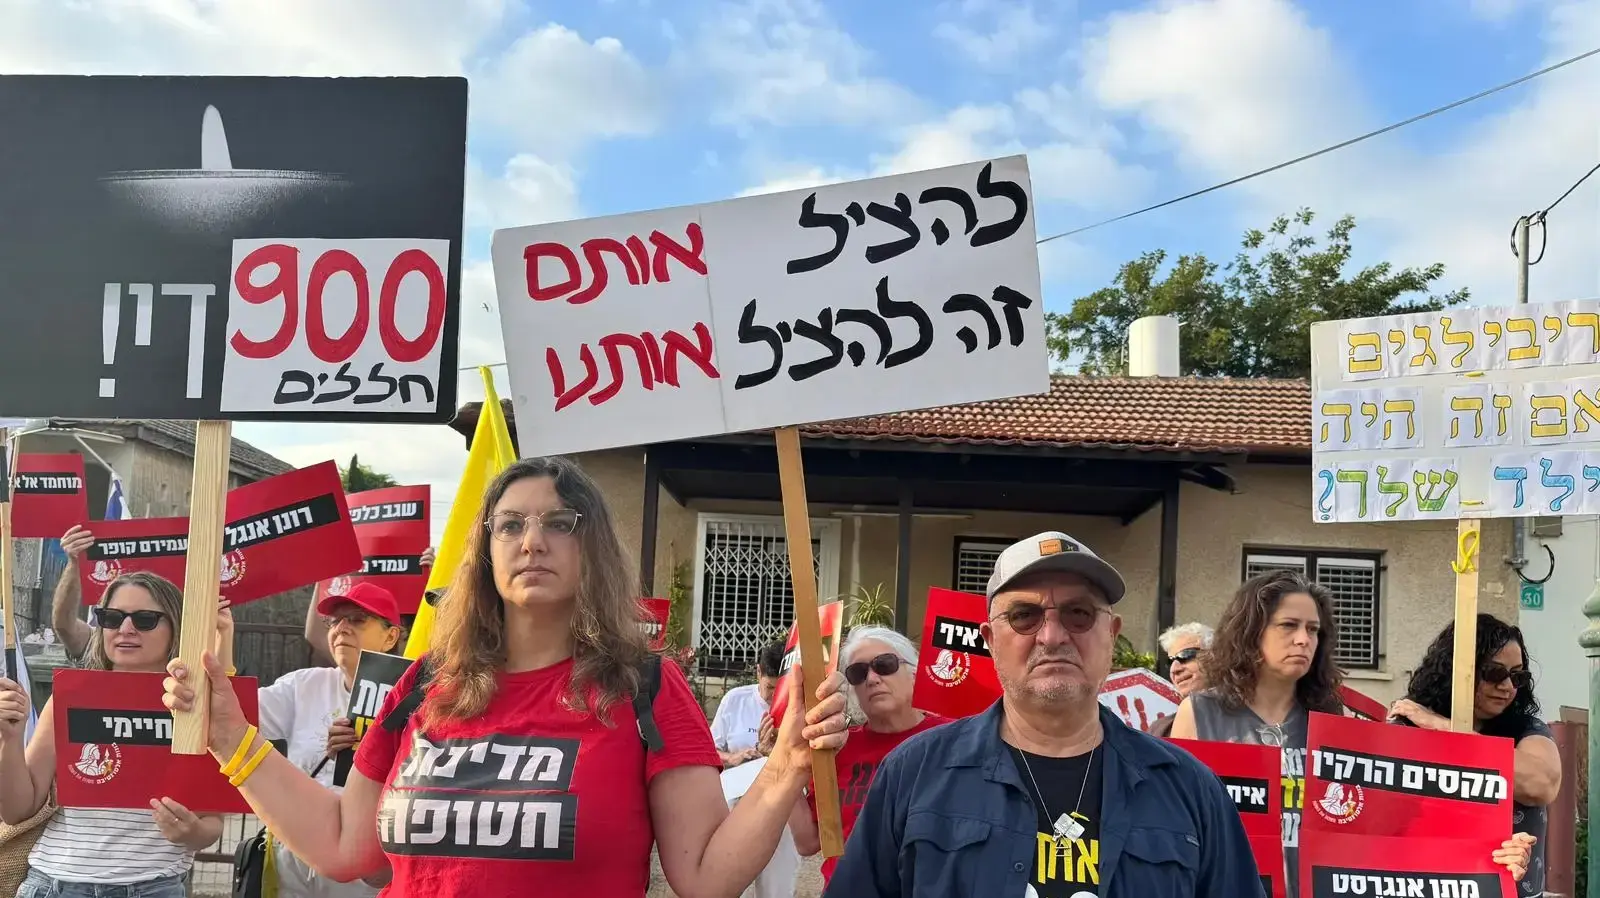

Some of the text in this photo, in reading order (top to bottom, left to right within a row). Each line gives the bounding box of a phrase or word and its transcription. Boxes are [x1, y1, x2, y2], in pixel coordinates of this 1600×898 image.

[523, 161, 1028, 304] להציל אותם
[230, 243, 446, 363] 900
[99, 282, 217, 399] די!
[545, 275, 1032, 412] זה להציל אותנו
[273, 363, 435, 405] חללים
[1320, 399, 1415, 443] היה
[1450, 394, 1512, 439] זה
[40, 475, 83, 489] מוחמד
[1318, 457, 1600, 520] ילד שלך?
[224, 506, 314, 547] רונן אנגל
[381, 502, 417, 518] שגב
[98, 538, 188, 555] עמירם קופר
[371, 558, 409, 572] עמרי
[1524, 592, 1541, 606] 30
[102, 716, 173, 739] חיימי
[401, 737, 564, 782] מדינת
[1312, 749, 1395, 786] הרקין
[1402, 764, 1507, 800] מקסים
[378, 798, 562, 849] חטופה
[1332, 873, 1480, 898] מתן אנגרסט
